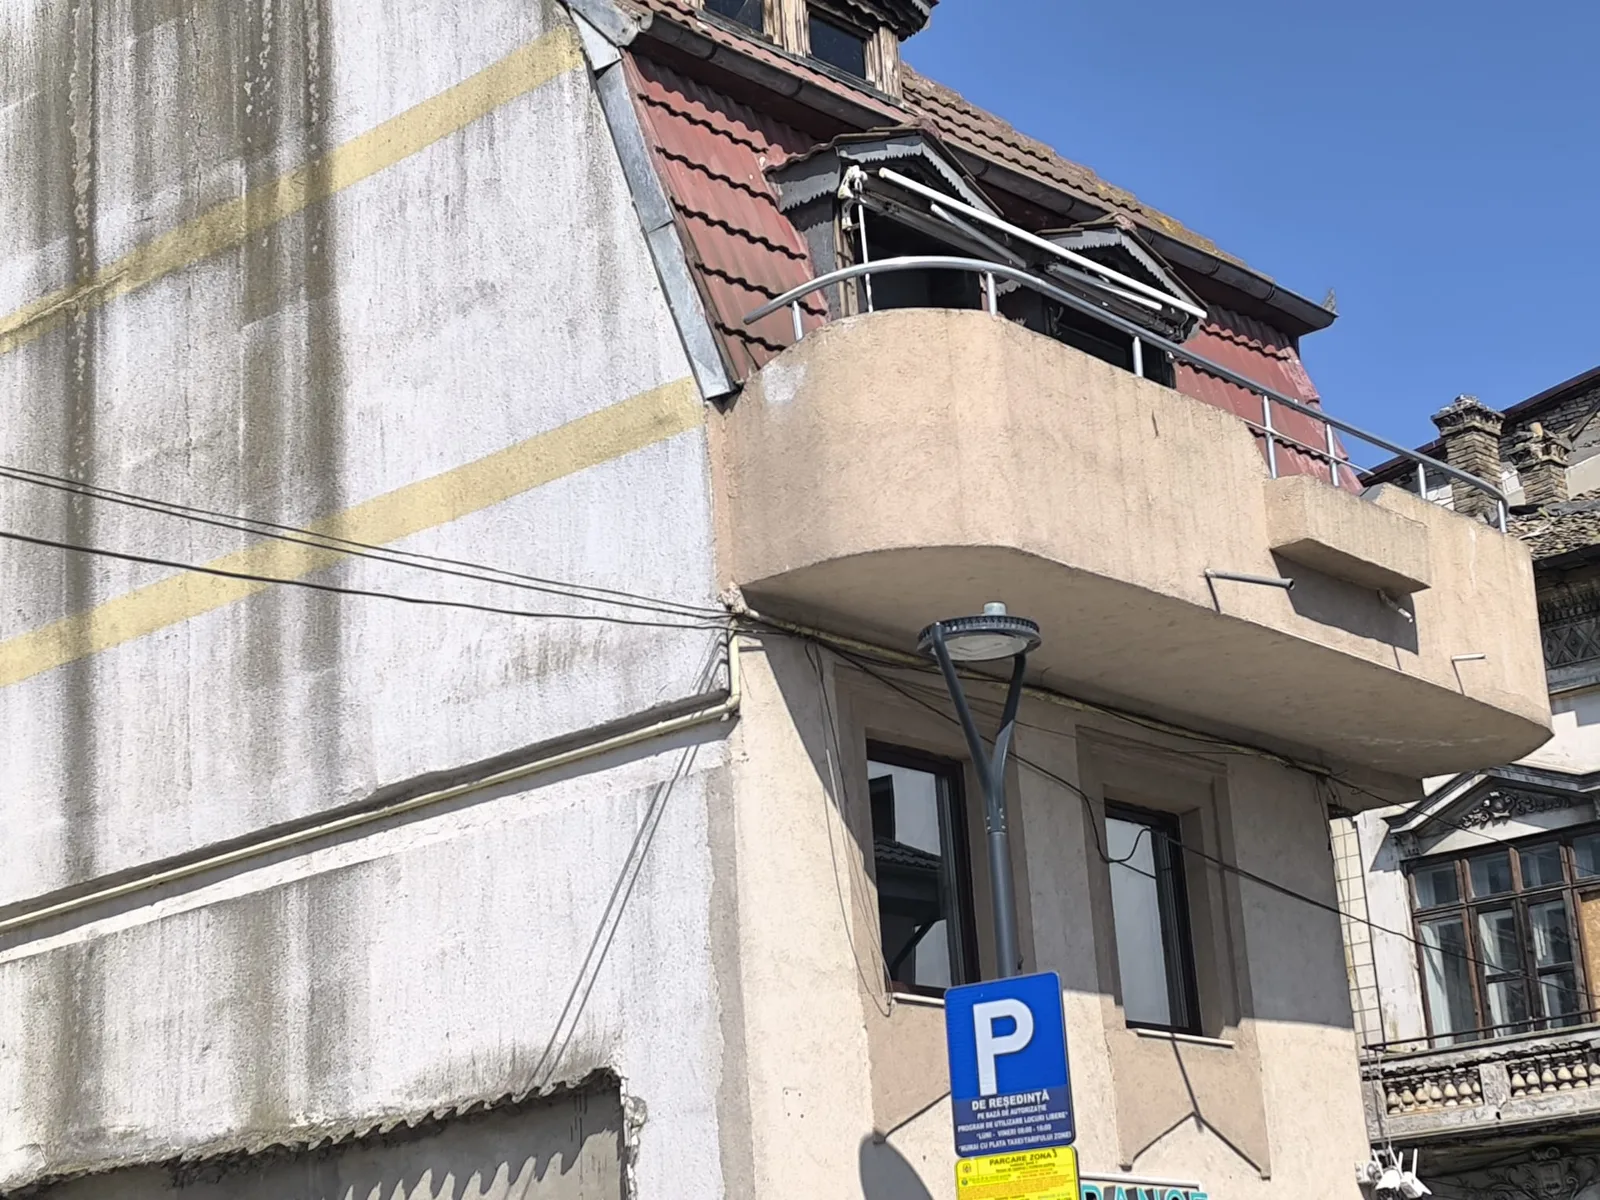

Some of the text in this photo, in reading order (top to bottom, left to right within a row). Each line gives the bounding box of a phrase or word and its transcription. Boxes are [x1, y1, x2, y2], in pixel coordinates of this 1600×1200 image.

[973, 999, 1034, 1096] P
[971, 1099, 987, 1111] DE
[977, 1112, 985, 1120] PE
[1001, 1109, 1010, 1117] DE
[957, 1122, 985, 1132] PROGRAM
[985, 1121, 994, 1129] DE
[994, 1117, 1023, 1128] UTILIZARE
[1023, 1114, 1045, 1124] LOCURI
[997, 1128, 1017, 1137] VINERI
[980, 1142, 988, 1150] CU
[989, 1139, 1007, 1149] PLATA
[989, 1154, 1027, 1166] PARCARE
[1029, 1151, 1052, 1161] ZONA
